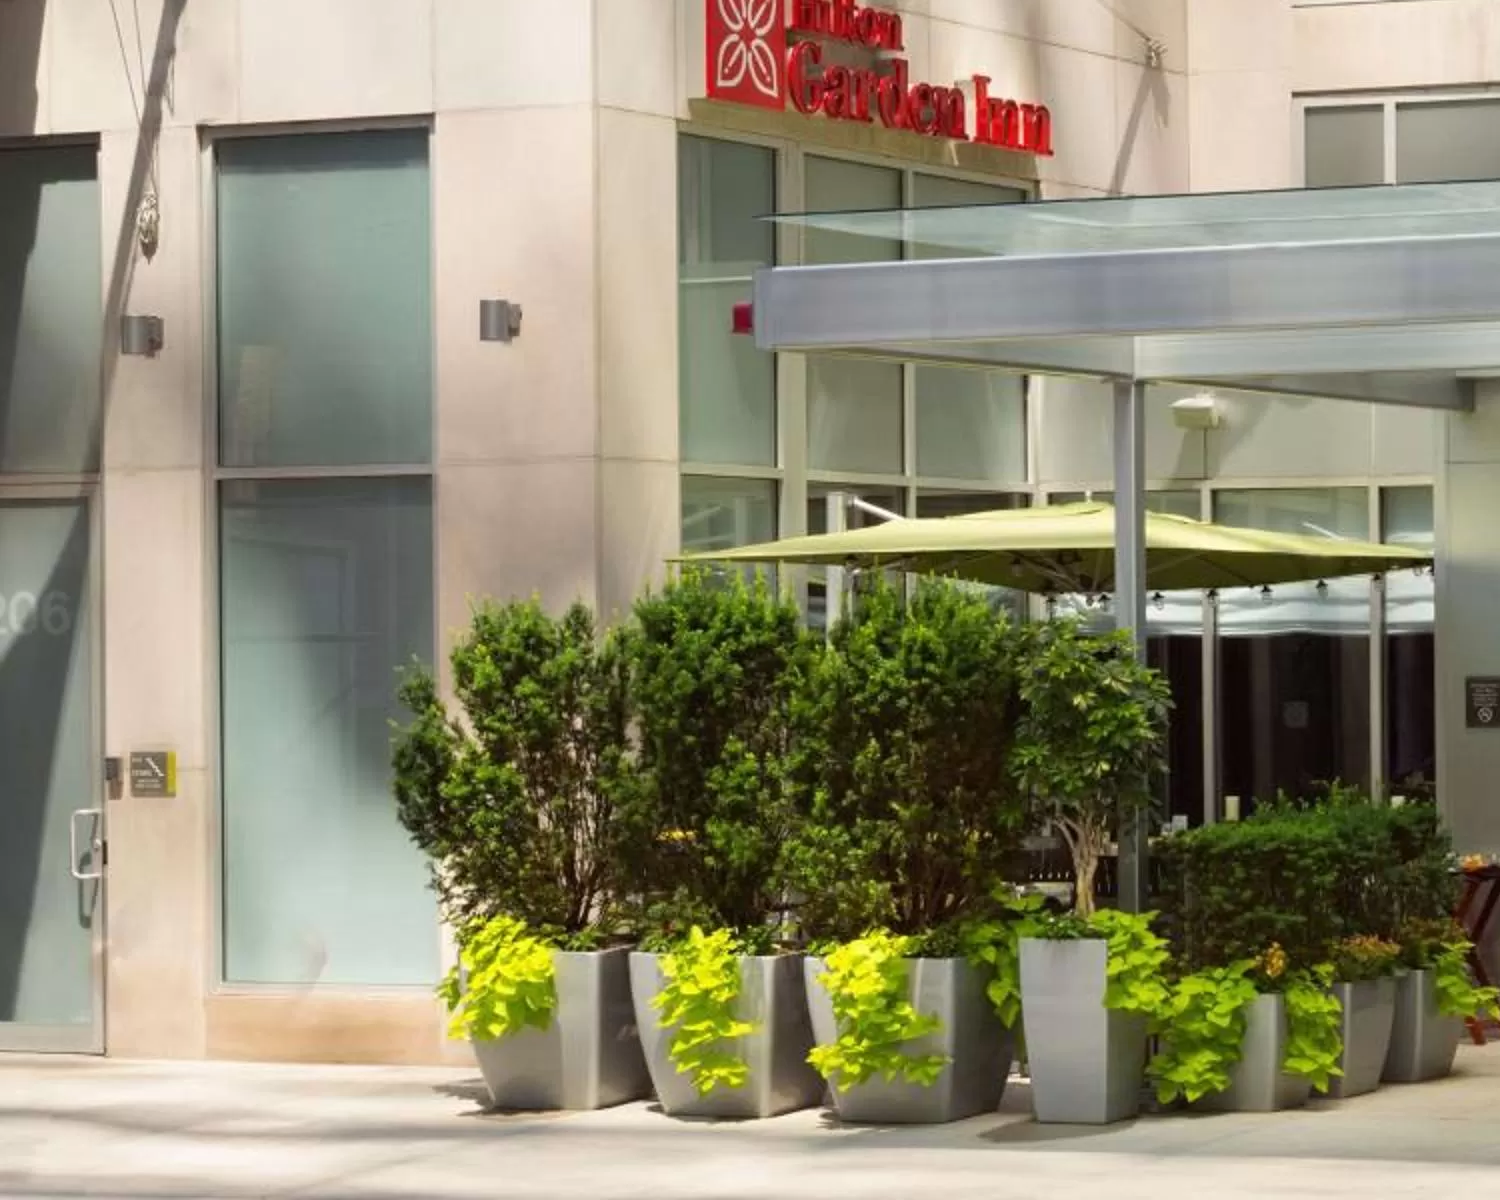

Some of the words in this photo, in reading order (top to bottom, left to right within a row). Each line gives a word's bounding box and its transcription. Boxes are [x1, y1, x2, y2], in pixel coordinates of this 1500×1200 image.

[788, 41, 969, 140] Garden
[971, 74, 1054, 156] Inn
[0, 590, 71, 634] 06
